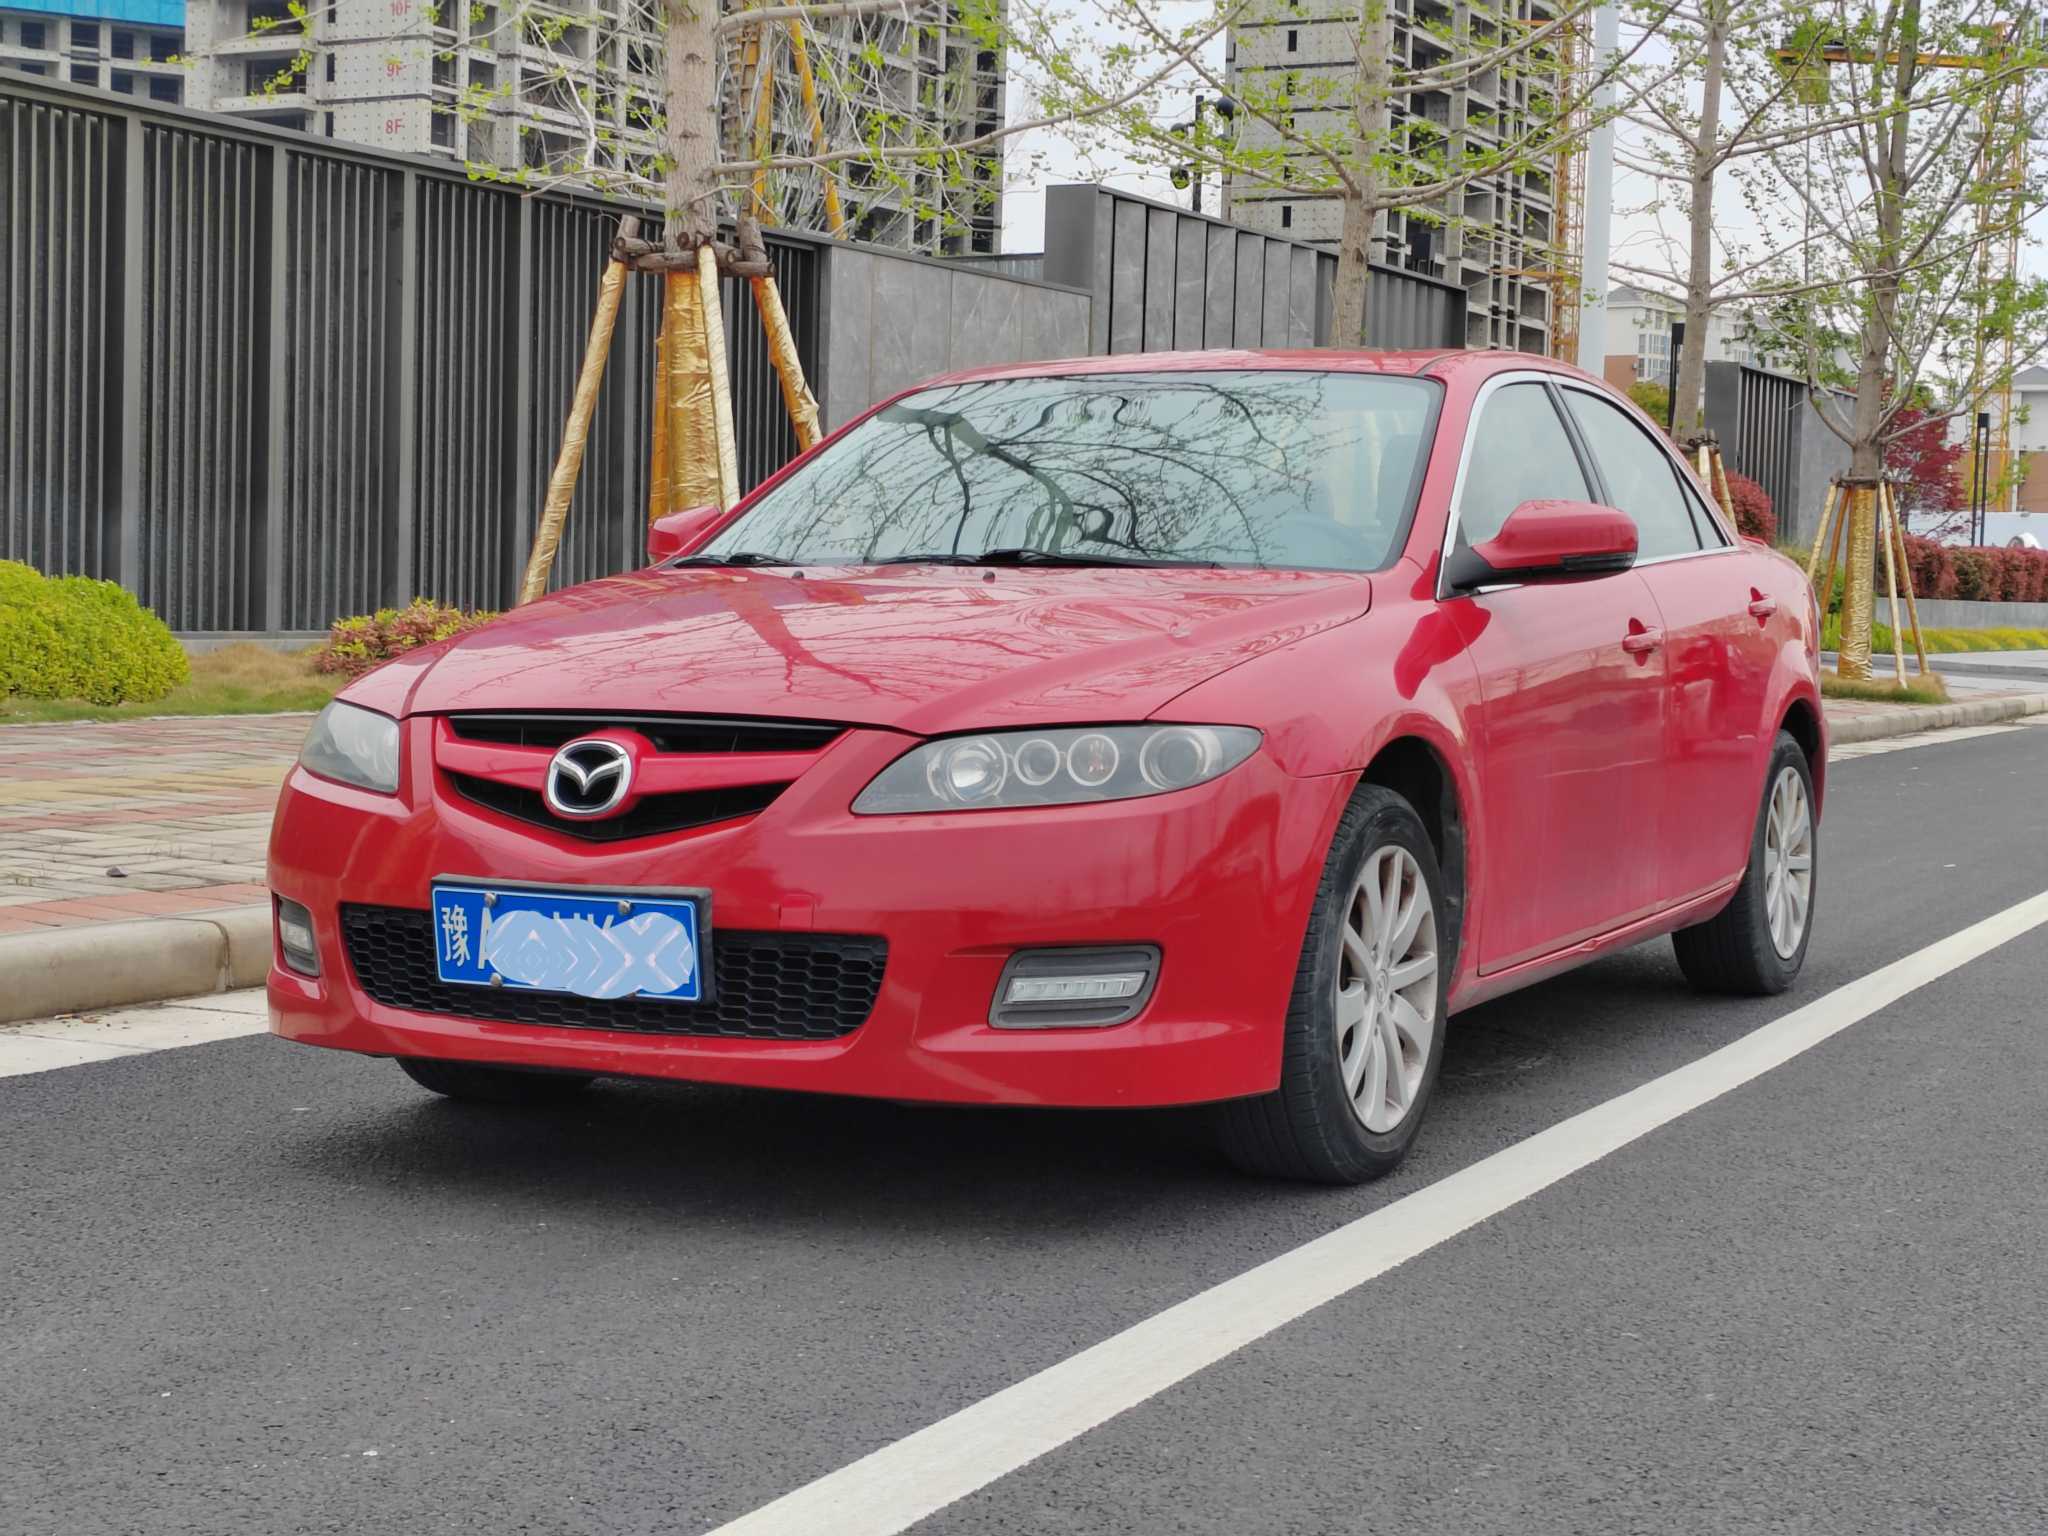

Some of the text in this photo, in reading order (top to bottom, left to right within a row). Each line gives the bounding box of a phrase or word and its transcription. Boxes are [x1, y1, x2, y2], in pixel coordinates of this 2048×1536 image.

[390, 0, 412, 16] 10F
[385, 118, 403, 134] 8F
[441, 904, 470, 967] 豫
